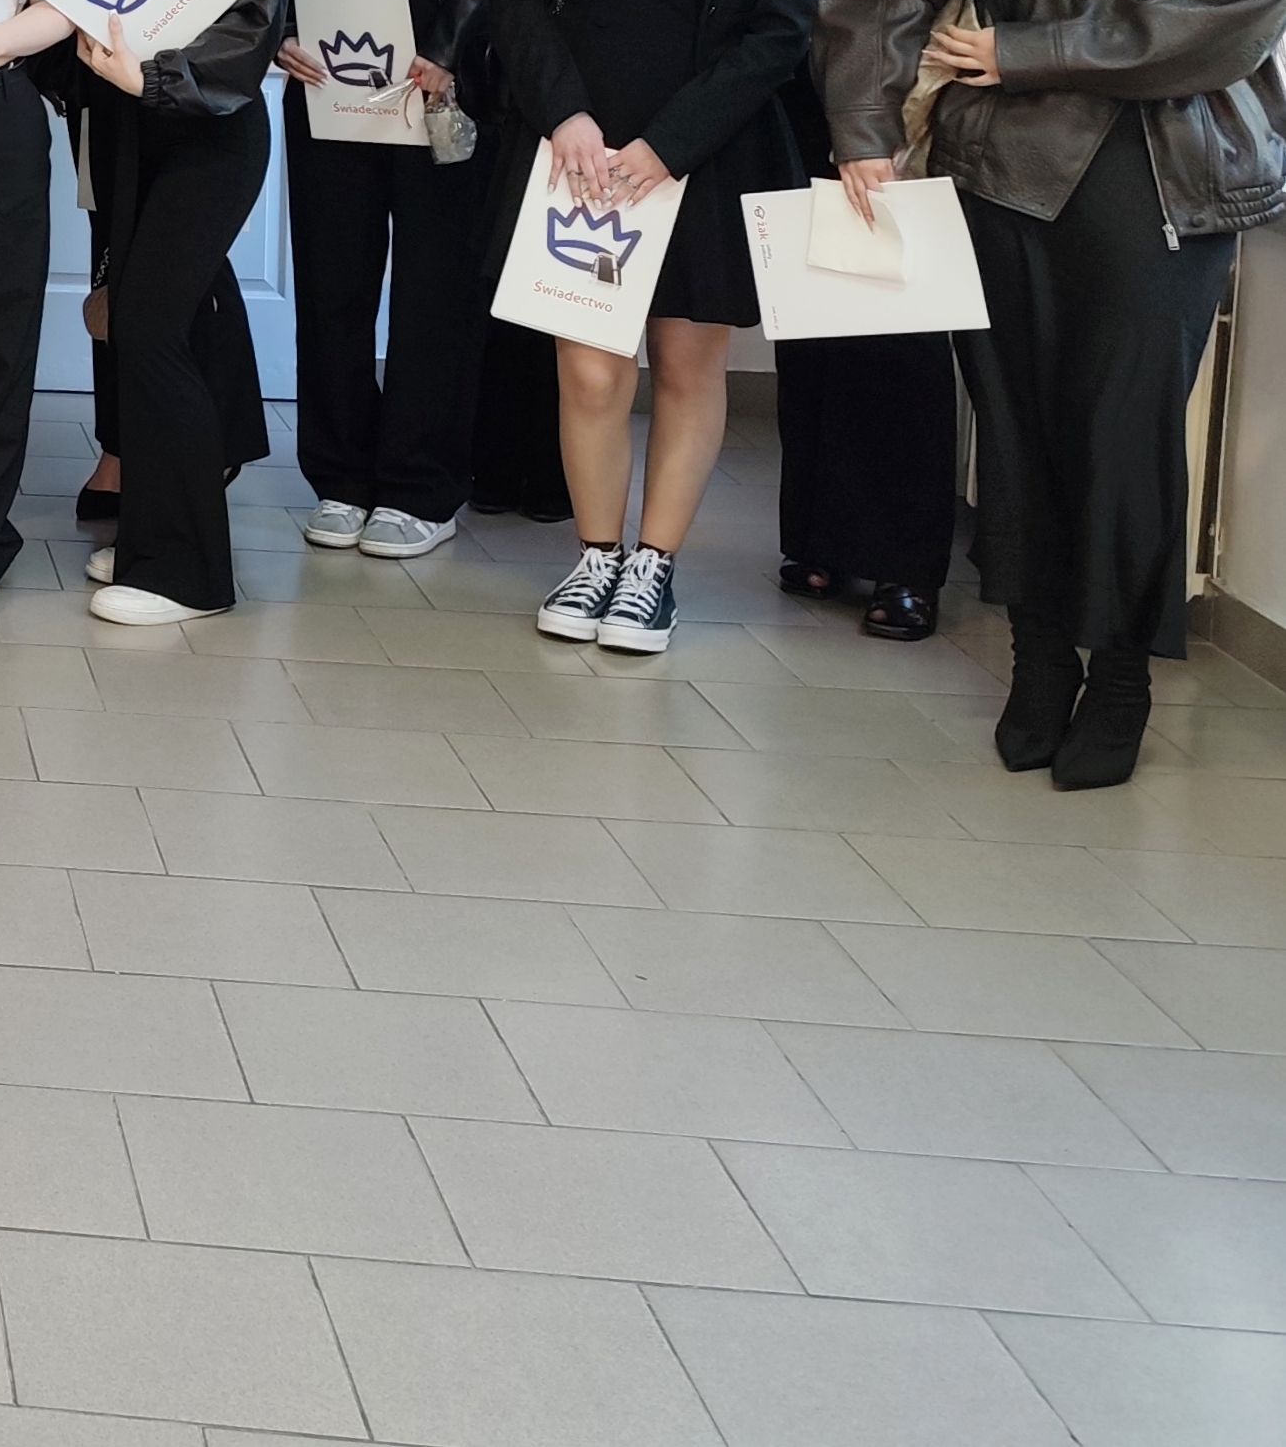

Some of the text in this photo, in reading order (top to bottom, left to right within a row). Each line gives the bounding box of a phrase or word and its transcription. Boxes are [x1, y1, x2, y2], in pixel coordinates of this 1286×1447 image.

[333, 101, 399, 116] Świadectwo
[756, 221, 769, 241] żak
[533, 279, 613, 313] Świadectwo
